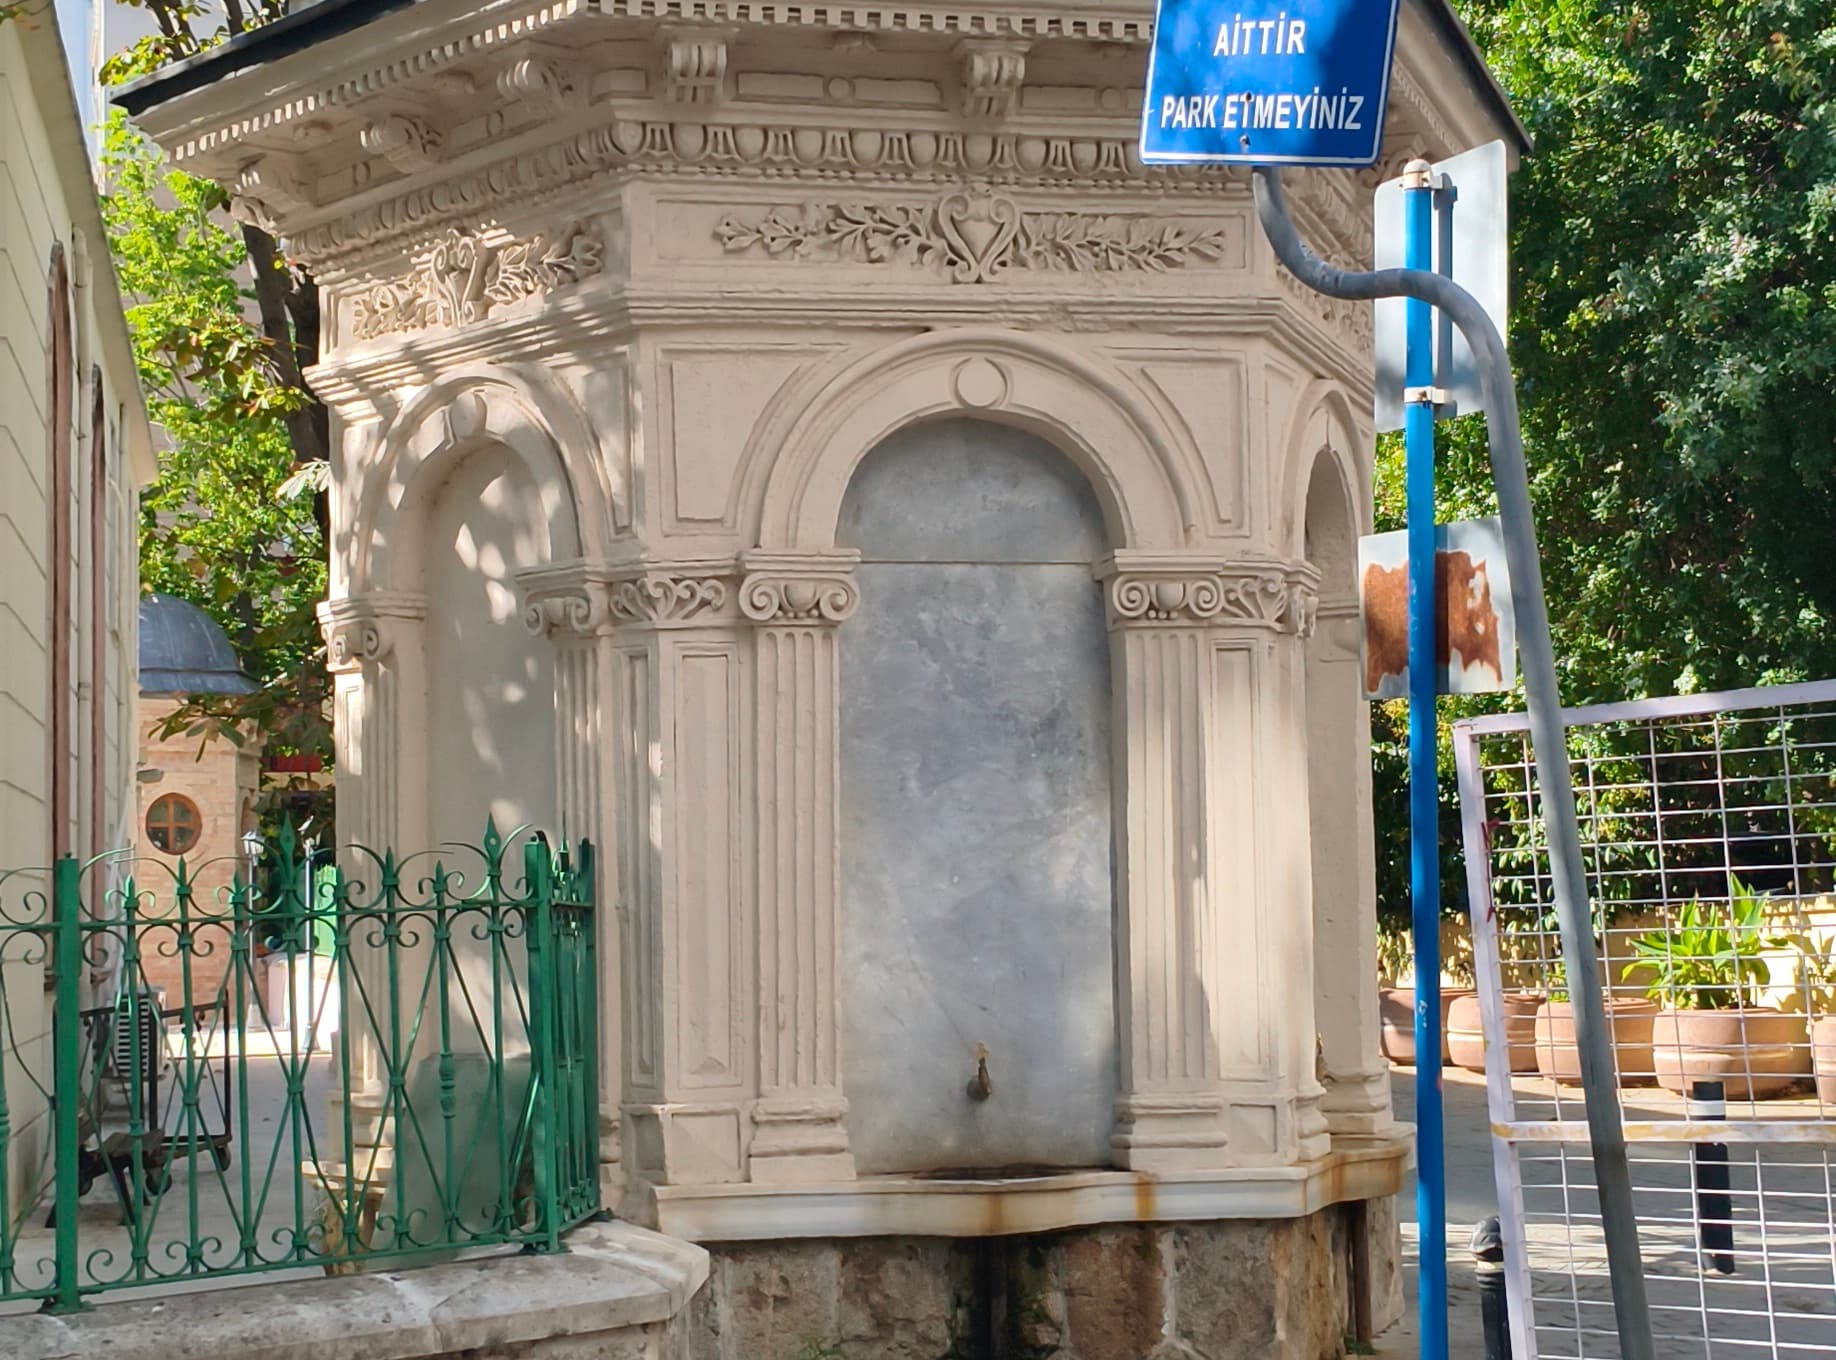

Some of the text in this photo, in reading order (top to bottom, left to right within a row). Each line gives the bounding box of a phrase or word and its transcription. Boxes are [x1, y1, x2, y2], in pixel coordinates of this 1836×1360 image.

[1213, 12, 1307, 56] AİTTİR
[1160, 87, 1364, 130] PARK ETMEYİNİZ
